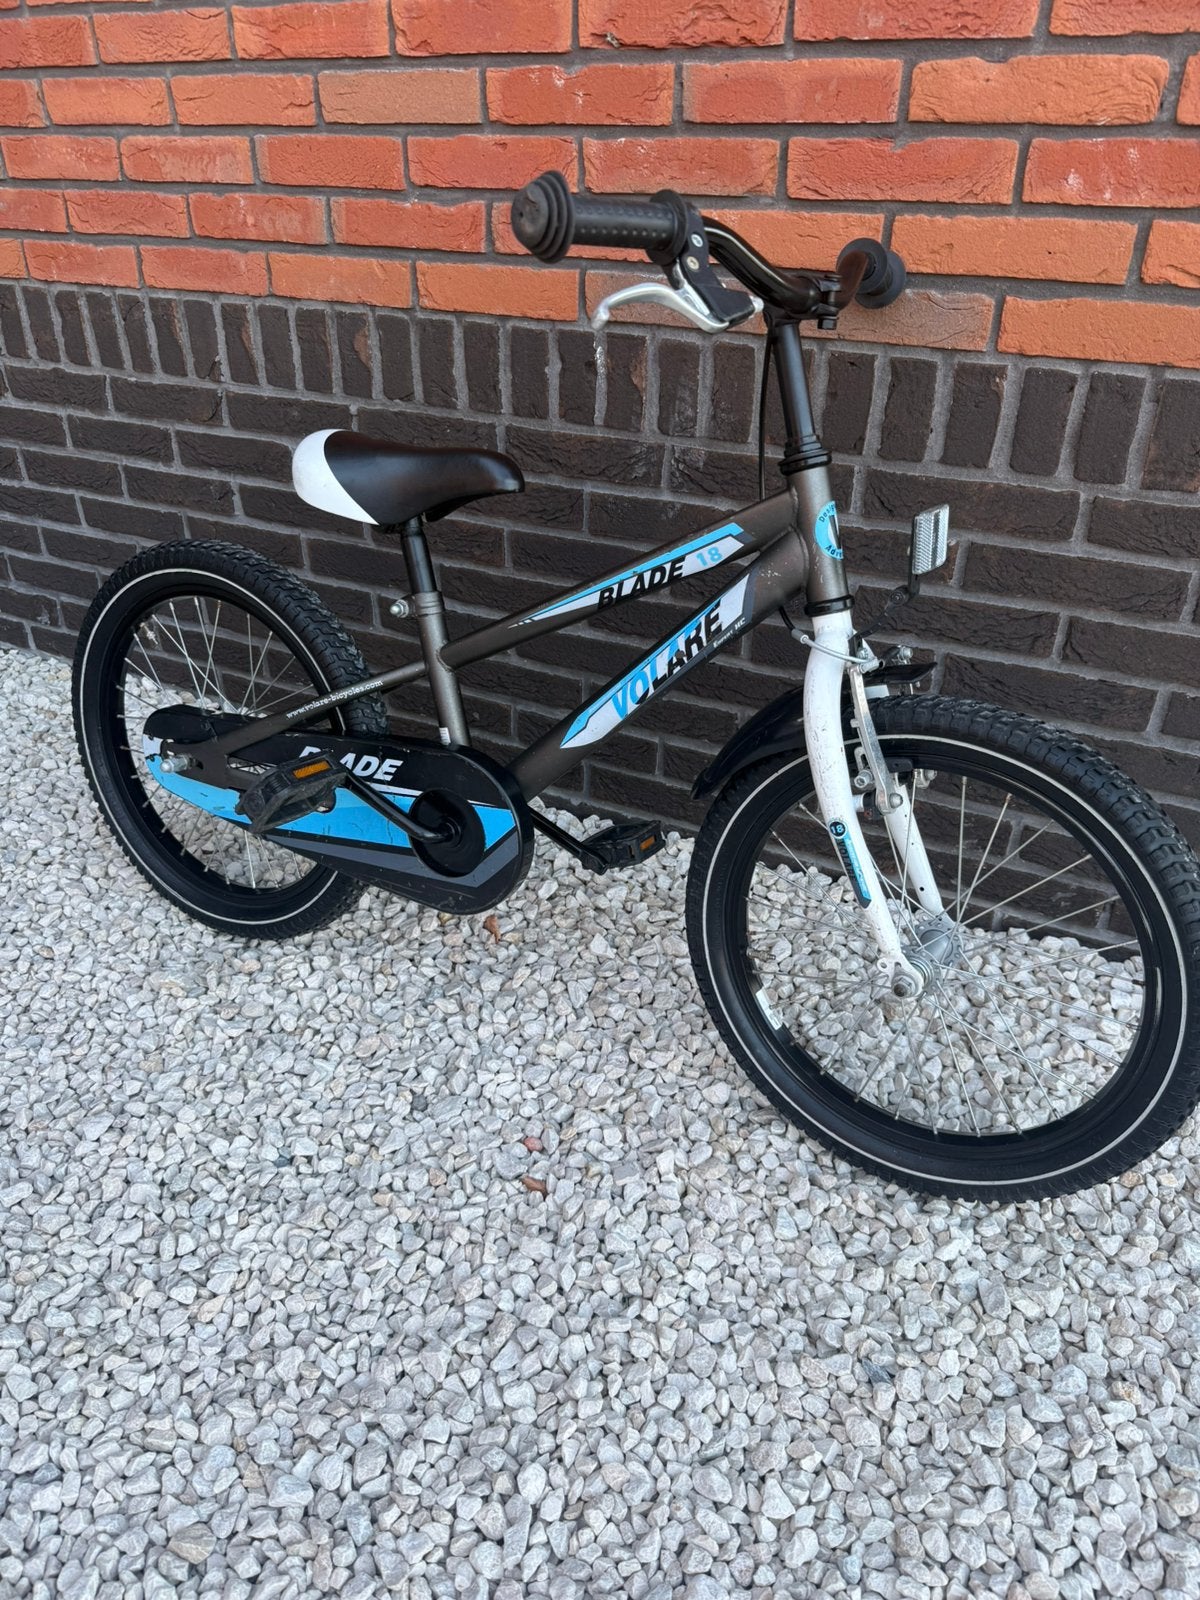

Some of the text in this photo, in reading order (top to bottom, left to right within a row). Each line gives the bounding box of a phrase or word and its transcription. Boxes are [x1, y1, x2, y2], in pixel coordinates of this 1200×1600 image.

[598, 547, 723, 609] BLADE 18
[611, 598, 723, 720] VOLARE
[286, 680, 384, 719] www.volare-bicycles.com
[299, 745, 404, 781] ADE
[831, 824, 844, 834] 18
